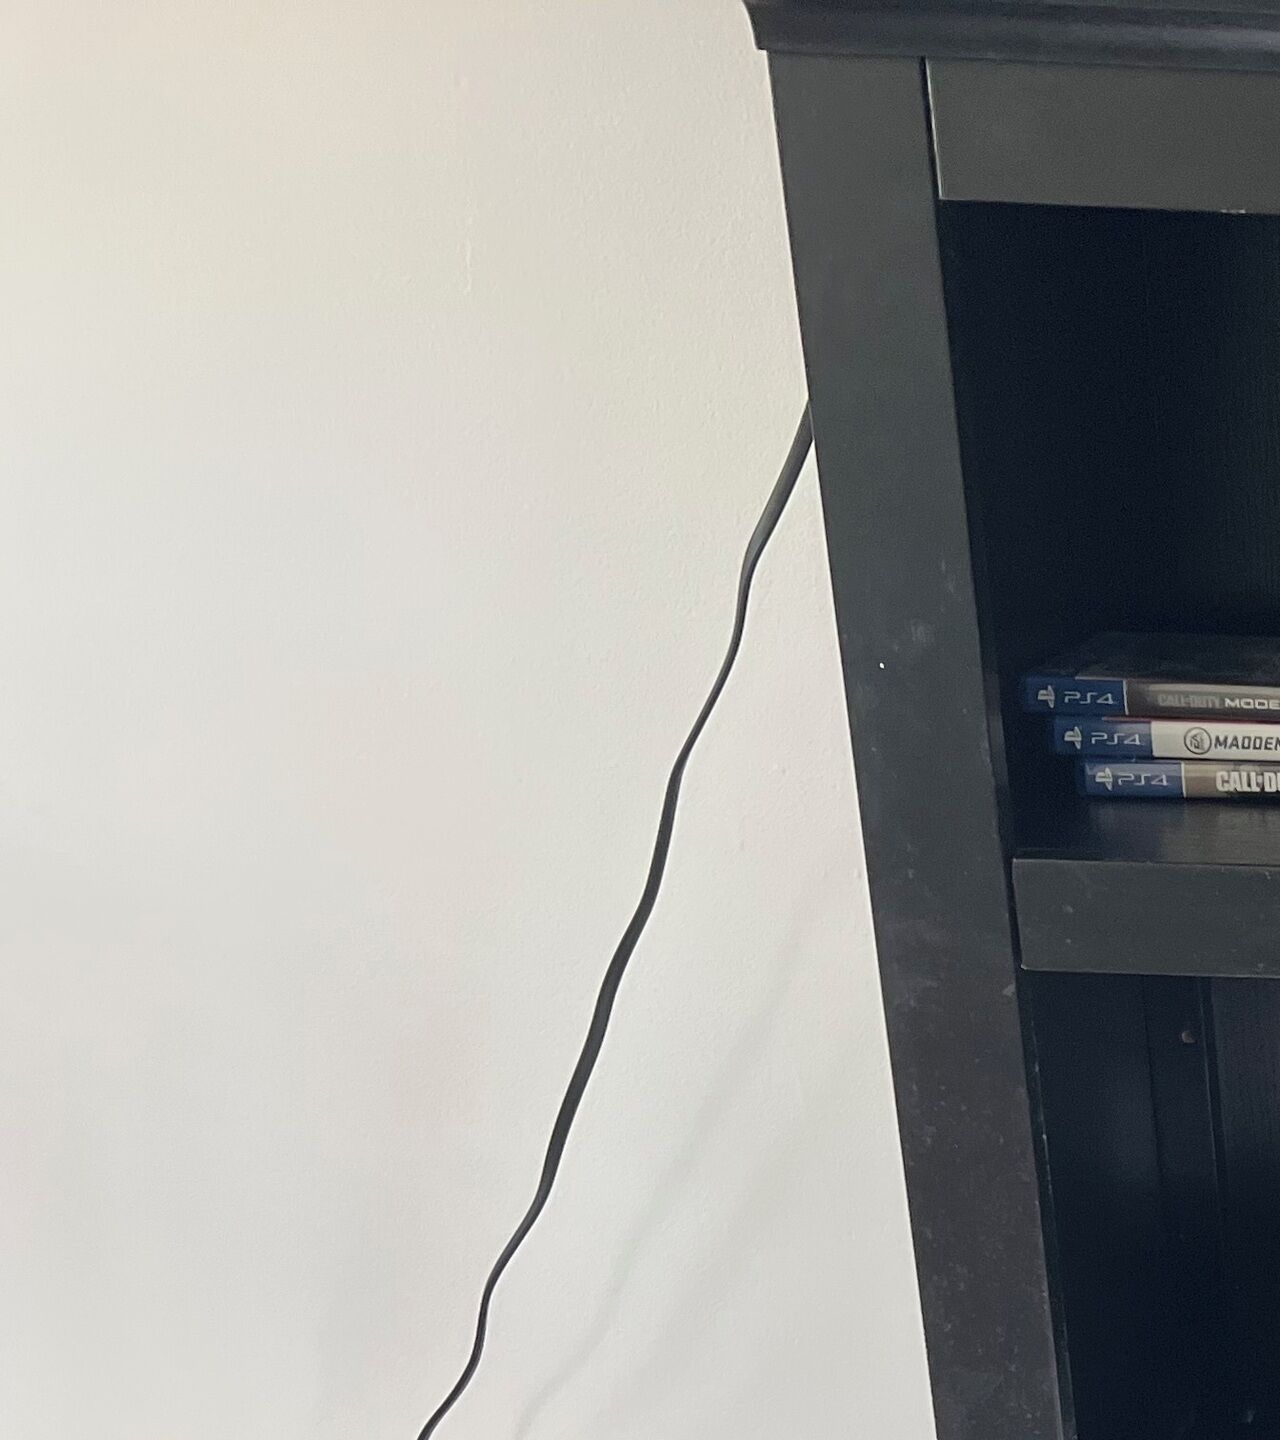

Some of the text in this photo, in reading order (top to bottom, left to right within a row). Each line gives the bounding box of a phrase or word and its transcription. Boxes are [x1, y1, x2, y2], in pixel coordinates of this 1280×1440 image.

[1064, 691, 1114, 706] PS4
[1091, 732, 1142, 746] PS4
[1118, 773, 1170, 787] PS4
